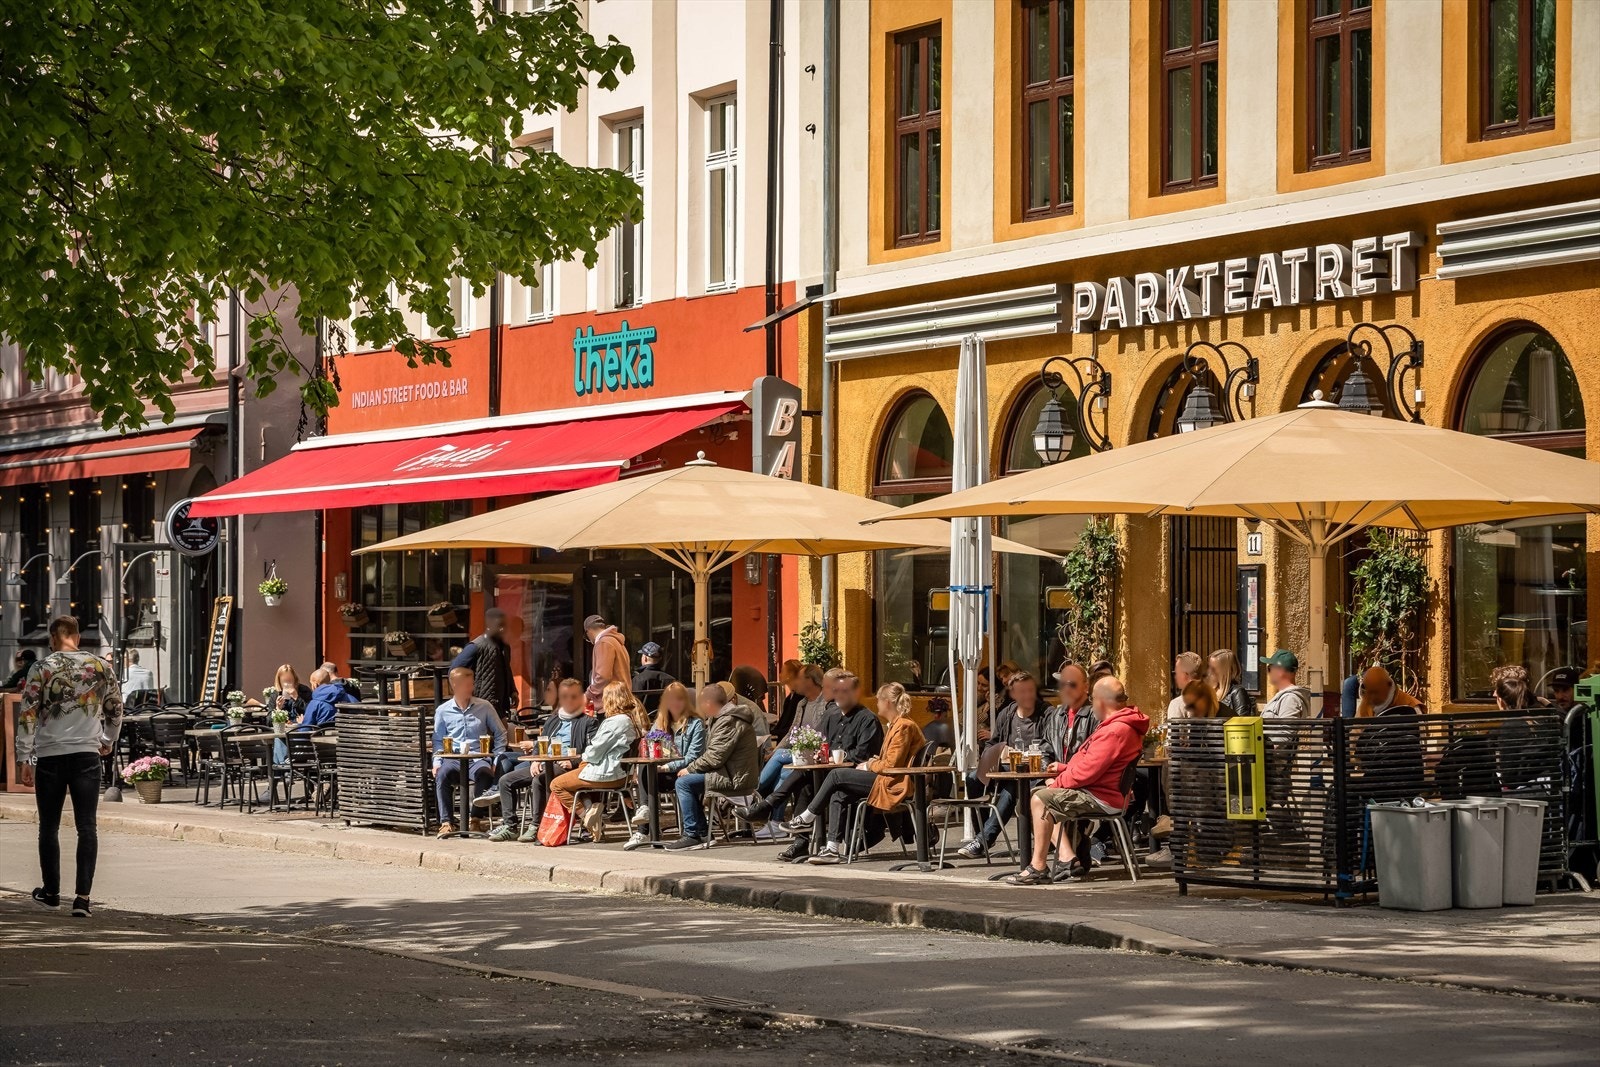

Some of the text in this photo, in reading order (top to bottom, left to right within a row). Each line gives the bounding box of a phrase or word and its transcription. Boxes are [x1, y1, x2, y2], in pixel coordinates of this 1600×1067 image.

[1073, 232, 1413, 334] PARKTEATRET
[352, 378, 468, 408] INDIAN STREET FOOD & BAR
[574, 320, 657, 396] theka
[769, 398, 798, 479] BA
[1249, 537, 1257, 551] 11
